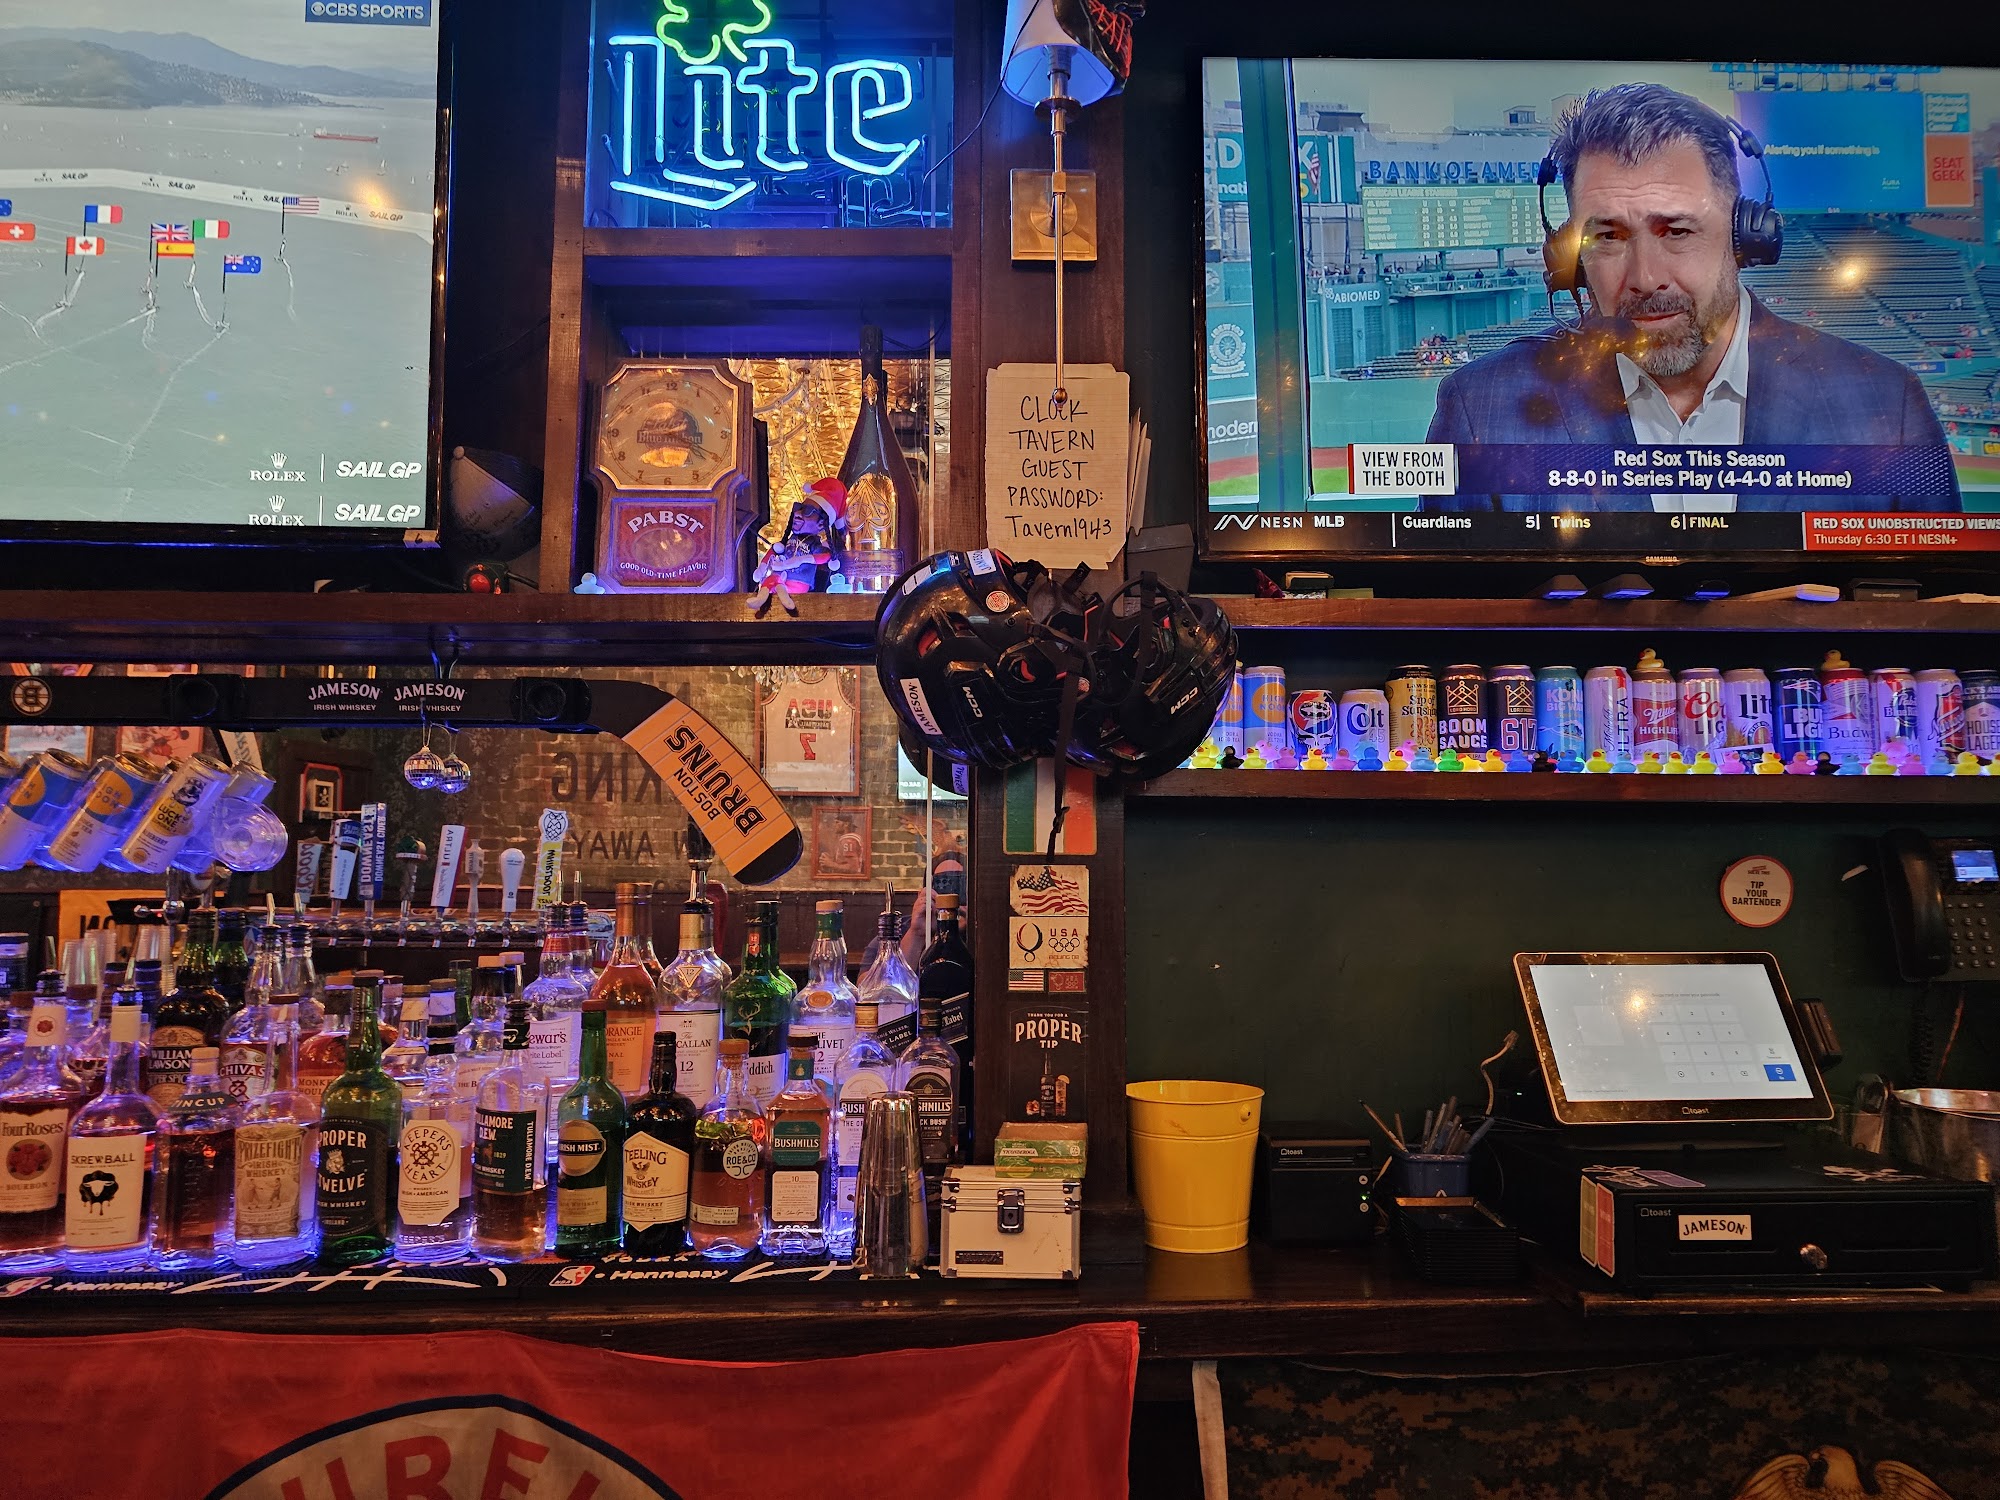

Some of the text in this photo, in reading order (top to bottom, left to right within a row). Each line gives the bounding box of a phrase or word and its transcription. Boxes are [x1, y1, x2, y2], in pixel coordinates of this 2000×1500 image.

[325, 2, 425, 20] CBS SPORTS
[608, 34, 921, 211] Lite
[1369, 160, 1475, 180] BANK OF
[1933, 156, 1964, 170] SEAT
[1932, 170, 1965, 182] GEEK
[1333, 289, 1381, 303] ABIOMED
[665, 382, 678, 391] 12
[713, 406, 721, 415] 2
[1021, 396, 1088, 422] CLOCK
[638, 432, 662, 444] Blue
[1009, 429, 1094, 453] TAVERN
[618, 451, 626, 461] 8
[1362, 451, 1445, 468] VIEW FROM
[1614, 449, 1785, 467] Red Sox This Season
[250, 470, 307, 482] ROLEX
[637, 470, 644, 479] 7
[692, 470, 699, 479] 5
[1022, 459, 1088, 480] GUEST
[664, 477, 672, 485] 6
[1362, 470, 1445, 487] THE BOOTH
[1548, 470, 1852, 490] 8-8-0 in Series Play (4-4-0 at Home)
[1007, 486, 1103, 508] PASSWORD:
[248, 514, 305, 527] ROLEX
[627, 510, 704, 533] PABST
[1005, 515, 1112, 540] Tavern1943
[1260, 515, 1345, 529] NESN MLB
[1402, 515, 1535, 530] Guardians 5
[1551, 515, 1680, 529] Twins 6
[1689, 516, 1729, 529] FINAL
[1813, 517, 1965, 530] RED SOX UNOBSTRUCTED
[1813, 533, 1958, 547] Thursday 6:30 ET NESN+
[620, 561, 707, 579] GOOD OLD-TIME FLAVOR
[308, 682, 381, 701] JAMESON
[393, 683, 466, 702] JAMESON
[962, 686, 984, 718] CCM
[1170, 686, 1199, 715] CCM
[1410, 694, 1436, 706] Sip of
[1546, 702, 1564, 712] BIG
[338, 704, 376, 712] WHISKEY
[908, 682, 938, 733] JAMESON
[1346, 703, 1385, 736] Colt
[1643, 706, 1676, 725] Miller
[1439, 718, 1488, 735] BOOM
[1639, 726, 1663, 735] HIGH
[1694, 720, 1725, 735] LIG
[1368, 728, 1386, 743] 45
[1501, 717, 1538, 751] 617
[1440, 734, 1488, 749] SAUCE
[663, 724, 767, 838] BRUINS
[672, 766, 721, 822] BOSTON
[157, 813, 178, 828] ONE
[1750, 880, 1764, 889] TIP
[1745, 888, 1768, 898] YOUR
[1732, 896, 1781, 907] BARTENDER
[1050, 928, 1079, 937] USA
[1015, 1018, 1082, 1044] PROPER
[528, 1032, 567, 1045] ewar's
[676, 1038, 713, 1048] CALLAN
[1039, 1039, 1058, 1049] TIP
[541, 1050, 563, 1059] Label
[149, 1058, 191, 1070] LAWSON
[219, 1064, 266, 1077] CHIVAS
[680, 1060, 694, 1072] 12
[918, 1101, 951, 1113] SHMILLS
[2, 1121, 64, 1137] Four Roses
[929, 1118, 947, 1126] BUSH
[524, 1120, 534, 1162] TULLAMORE
[774, 1138, 819, 1149] BUSHMILLS
[625, 1149, 667, 1166] TEELING
[1286, 1148, 1303, 1156] toast
[253, 1160, 277, 1169] IRISH
[246, 1168, 286, 1178] WHISKEY
[405, 1163, 446, 1181] HEART
[791, 1175, 799, 1183] 10
[6, 1181, 49, 1191] BOURBON
[318, 1173, 366, 1193] TWELVE
[625, 1176, 660, 1189] WHISKEY
[330, 1200, 367, 1208] WHISKEY
[1649, 1208, 1672, 1217] toast
[1683, 1219, 1746, 1236] JAMESON
[609, 1269, 729, 1281] Hennessy
[54, 1281, 184, 1292] Hennessy
